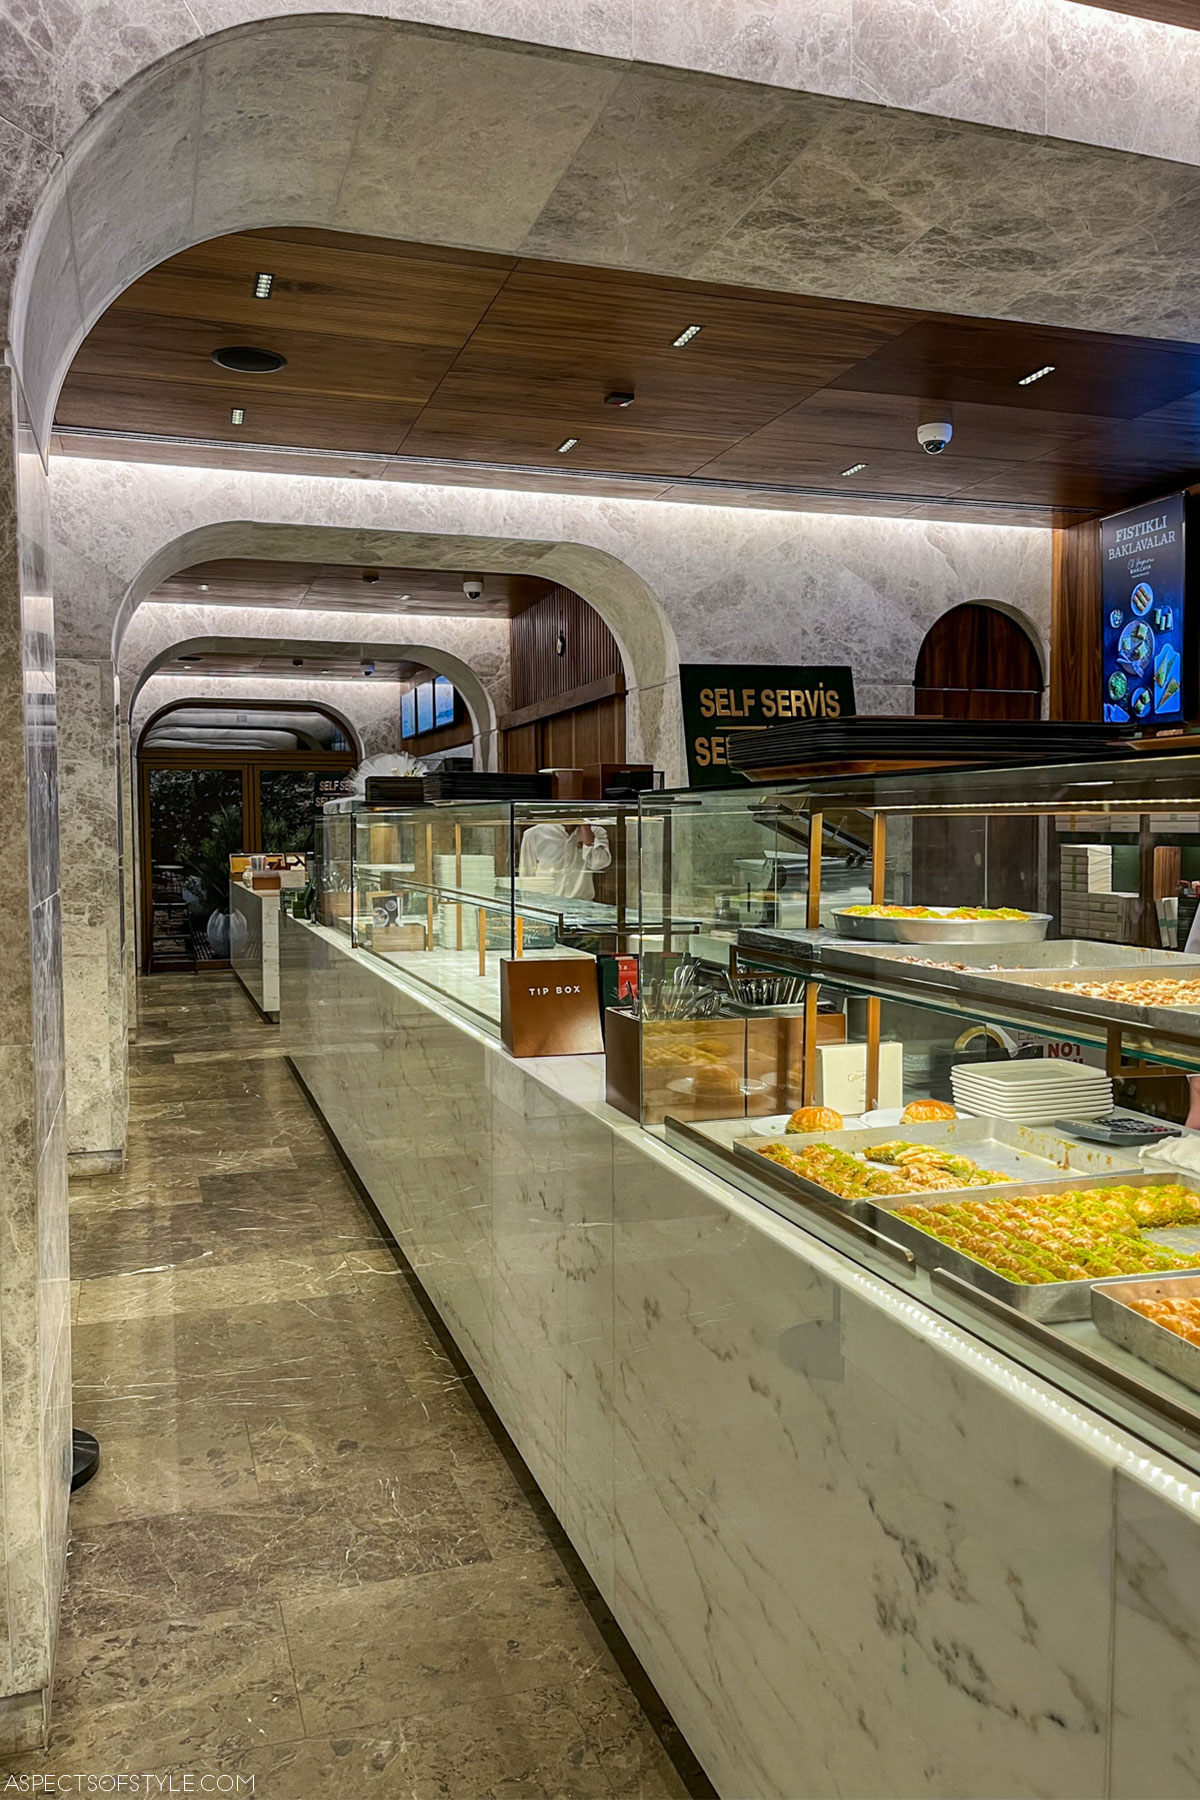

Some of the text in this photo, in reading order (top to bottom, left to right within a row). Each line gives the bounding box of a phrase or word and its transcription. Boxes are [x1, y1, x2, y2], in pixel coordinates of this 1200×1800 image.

[1115, 515, 1168, 543] FISTIKLI
[1108, 531, 1176, 560] BAKLAVALAR
[700, 682, 841, 719] SELF SERVİS
[319, 780, 339, 792] SELF
[528, 985, 581, 996] TIP BOX
